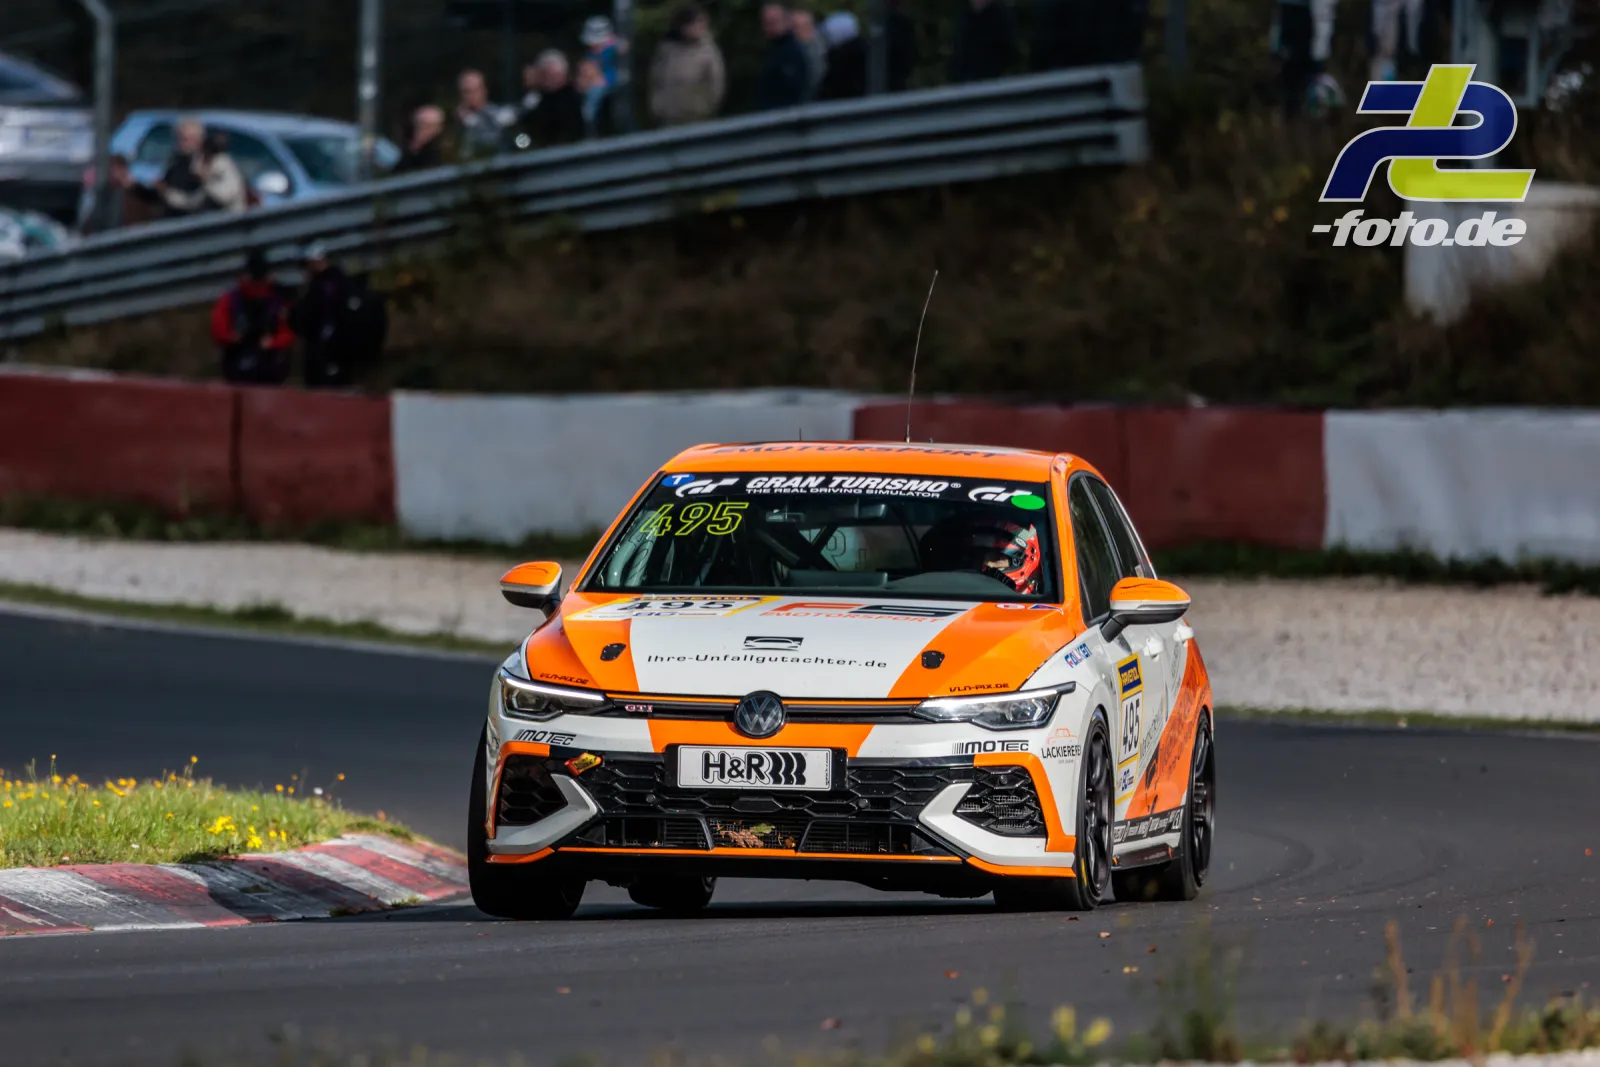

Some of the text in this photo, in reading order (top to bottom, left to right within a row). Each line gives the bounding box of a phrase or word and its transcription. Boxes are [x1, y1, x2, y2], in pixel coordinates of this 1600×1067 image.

[745, 476, 827, 490] GRAN
[865, 489, 940, 498] SIMULATOR
[639, 502, 750, 537] 495
[617, 601, 735, 611] 495
[647, 654, 888, 669] Ihre-Unfallgutachter.de
[949, 683, 1010, 693] VLN-PIX.DE
[624, 704, 653, 713] GTI
[1122, 699, 1140, 755] 495
[516, 729, 577, 746] MOTEC
[958, 740, 1029, 754] MOTEC
[702, 751, 771, 784] H&R
